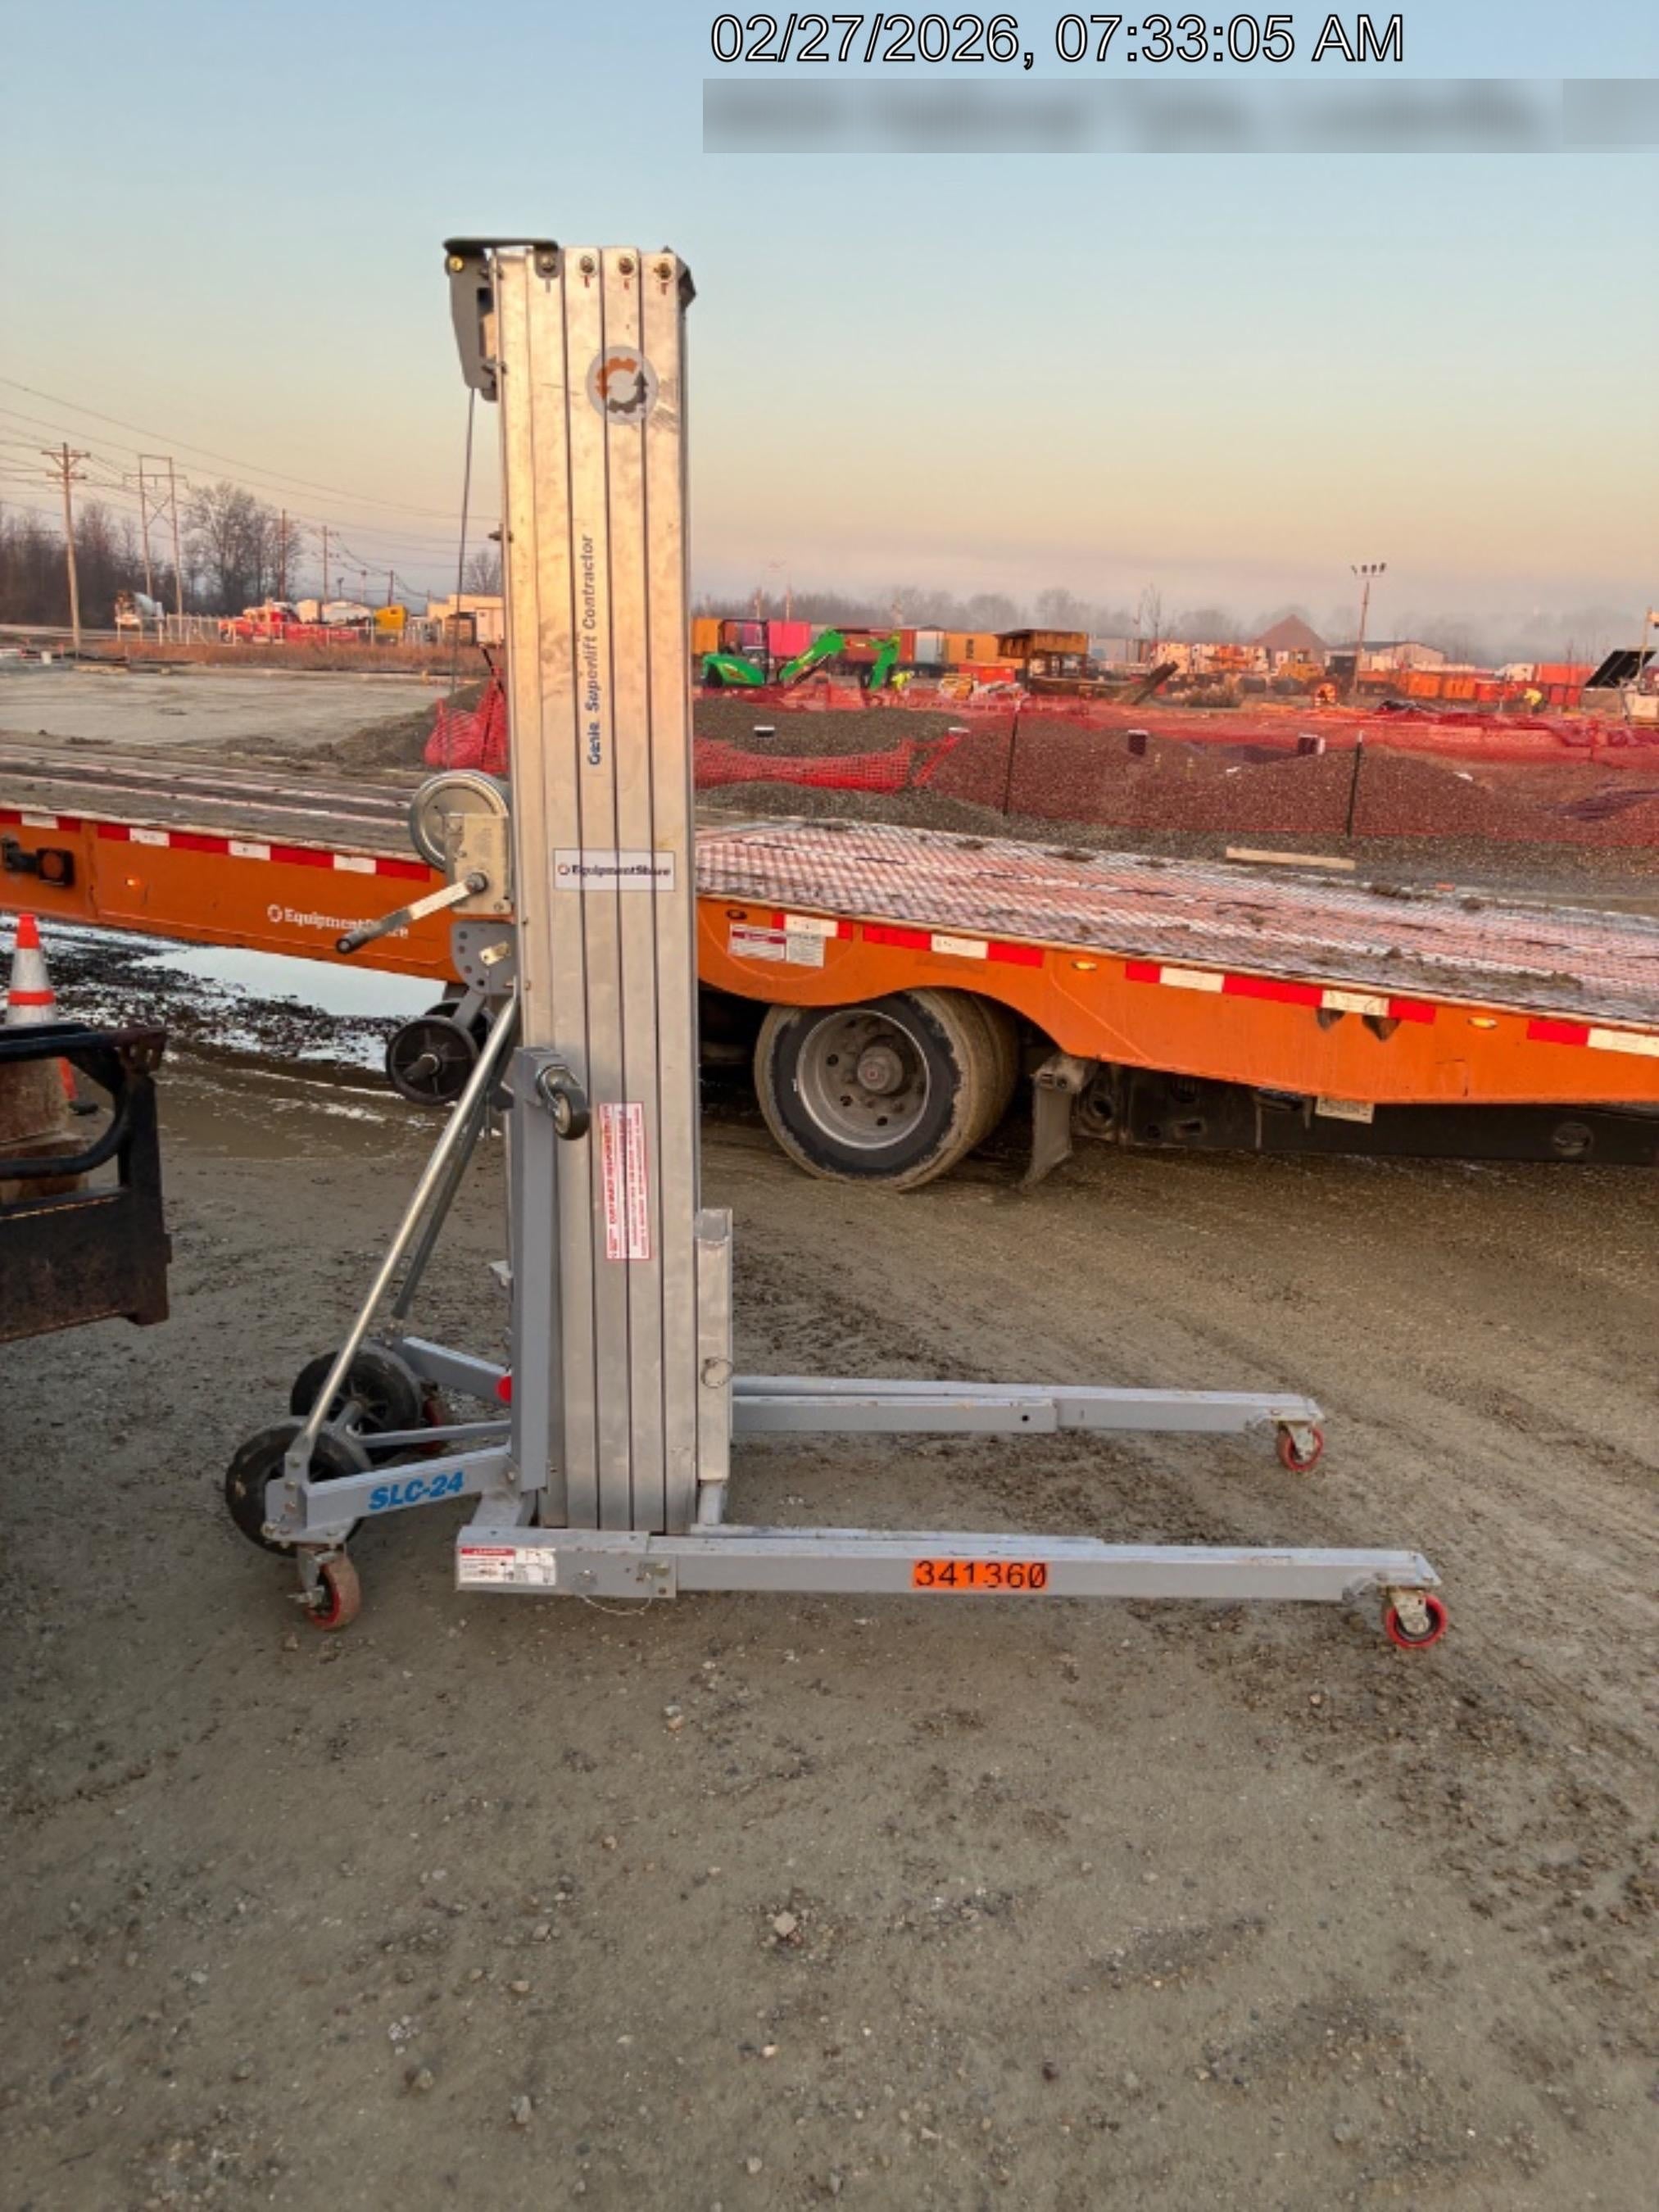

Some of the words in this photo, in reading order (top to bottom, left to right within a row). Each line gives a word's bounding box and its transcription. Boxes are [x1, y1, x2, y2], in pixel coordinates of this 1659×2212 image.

[581, 534, 596, 629] Contractor
[572, 864, 670, 877] EquipmentShare
[369, 1469, 464, 1510] SLC-24
[915, 1560, 1047, 1589] 341360
